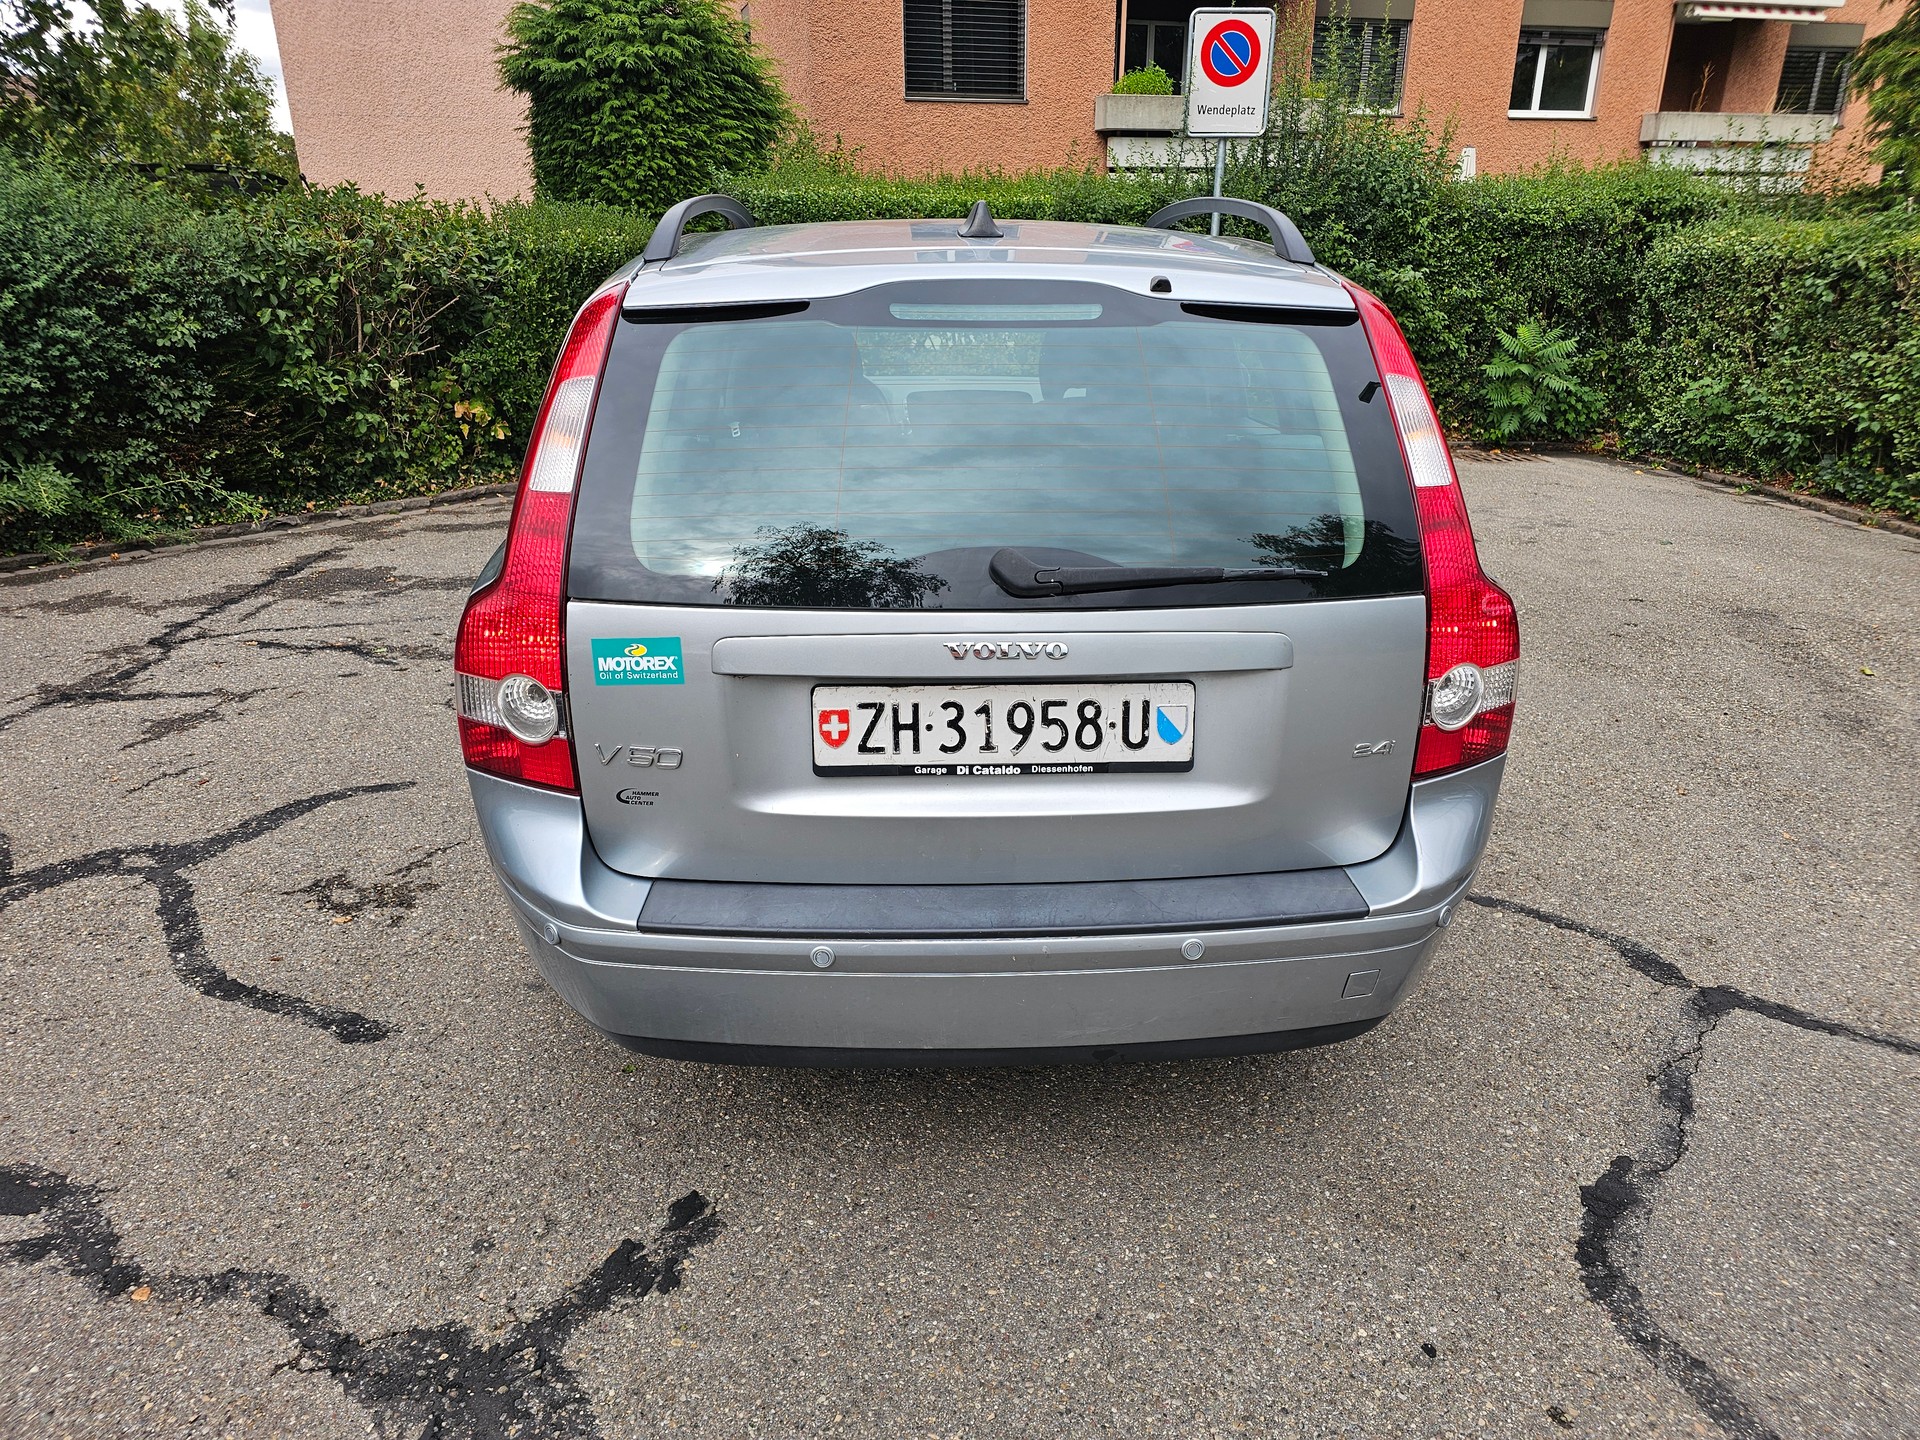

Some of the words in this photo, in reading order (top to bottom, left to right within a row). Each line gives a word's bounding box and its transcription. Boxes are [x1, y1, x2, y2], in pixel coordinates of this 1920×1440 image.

[1197, 104, 1256, 117] Wendeplatz
[943, 641, 1069, 660] VOLVO
[598, 656, 677, 671] MOTOREX
[627, 671, 679, 679] Switzerland
[914, 766, 948, 776] Garage
[956, 765, 970, 775] Di
[972, 765, 1021, 775] Cataldo
[1031, 764, 1094, 773] Diessenhofen
